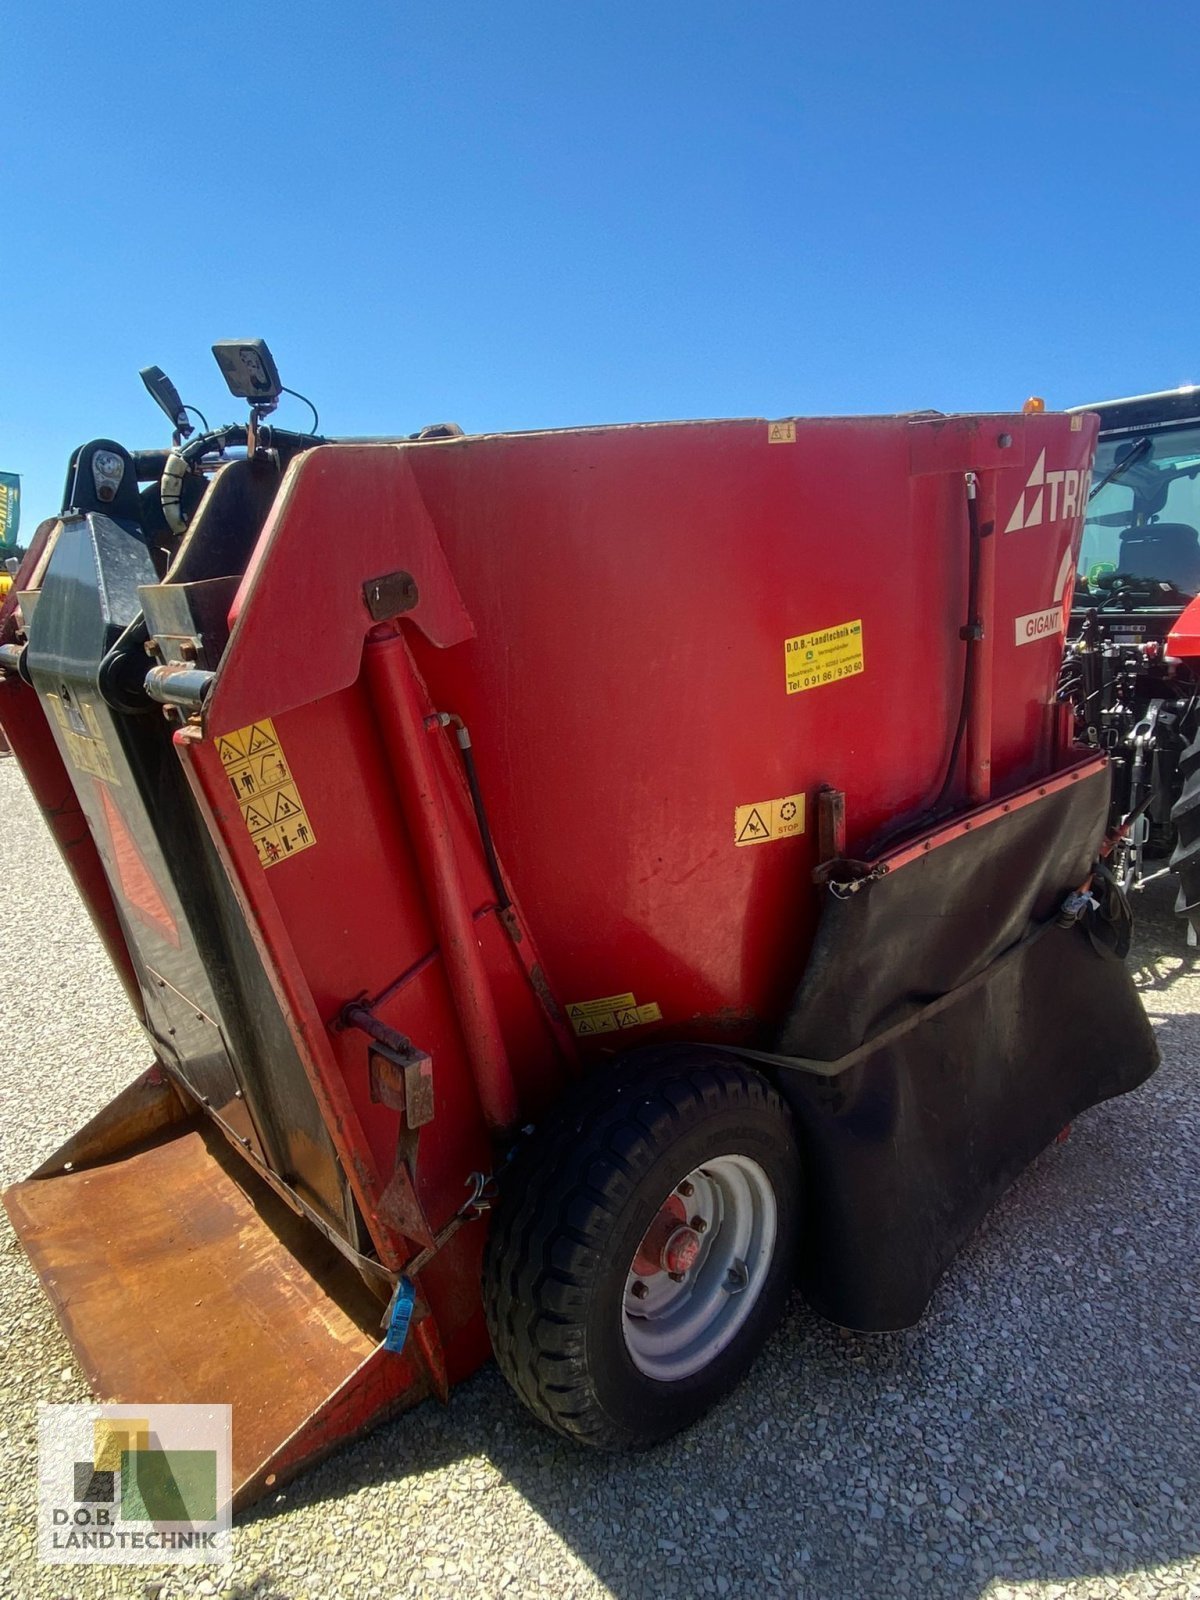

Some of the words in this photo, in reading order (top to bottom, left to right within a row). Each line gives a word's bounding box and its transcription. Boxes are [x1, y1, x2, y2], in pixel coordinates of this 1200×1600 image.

[1026, 612, 1059, 637] GIGANT
[788, 681, 802, 691] Tel.
[811, 674, 820, 685] 91
[822, 671, 832, 681] 86
[837, 668, 842, 676] 9
[778, 823, 799, 834] STOP
